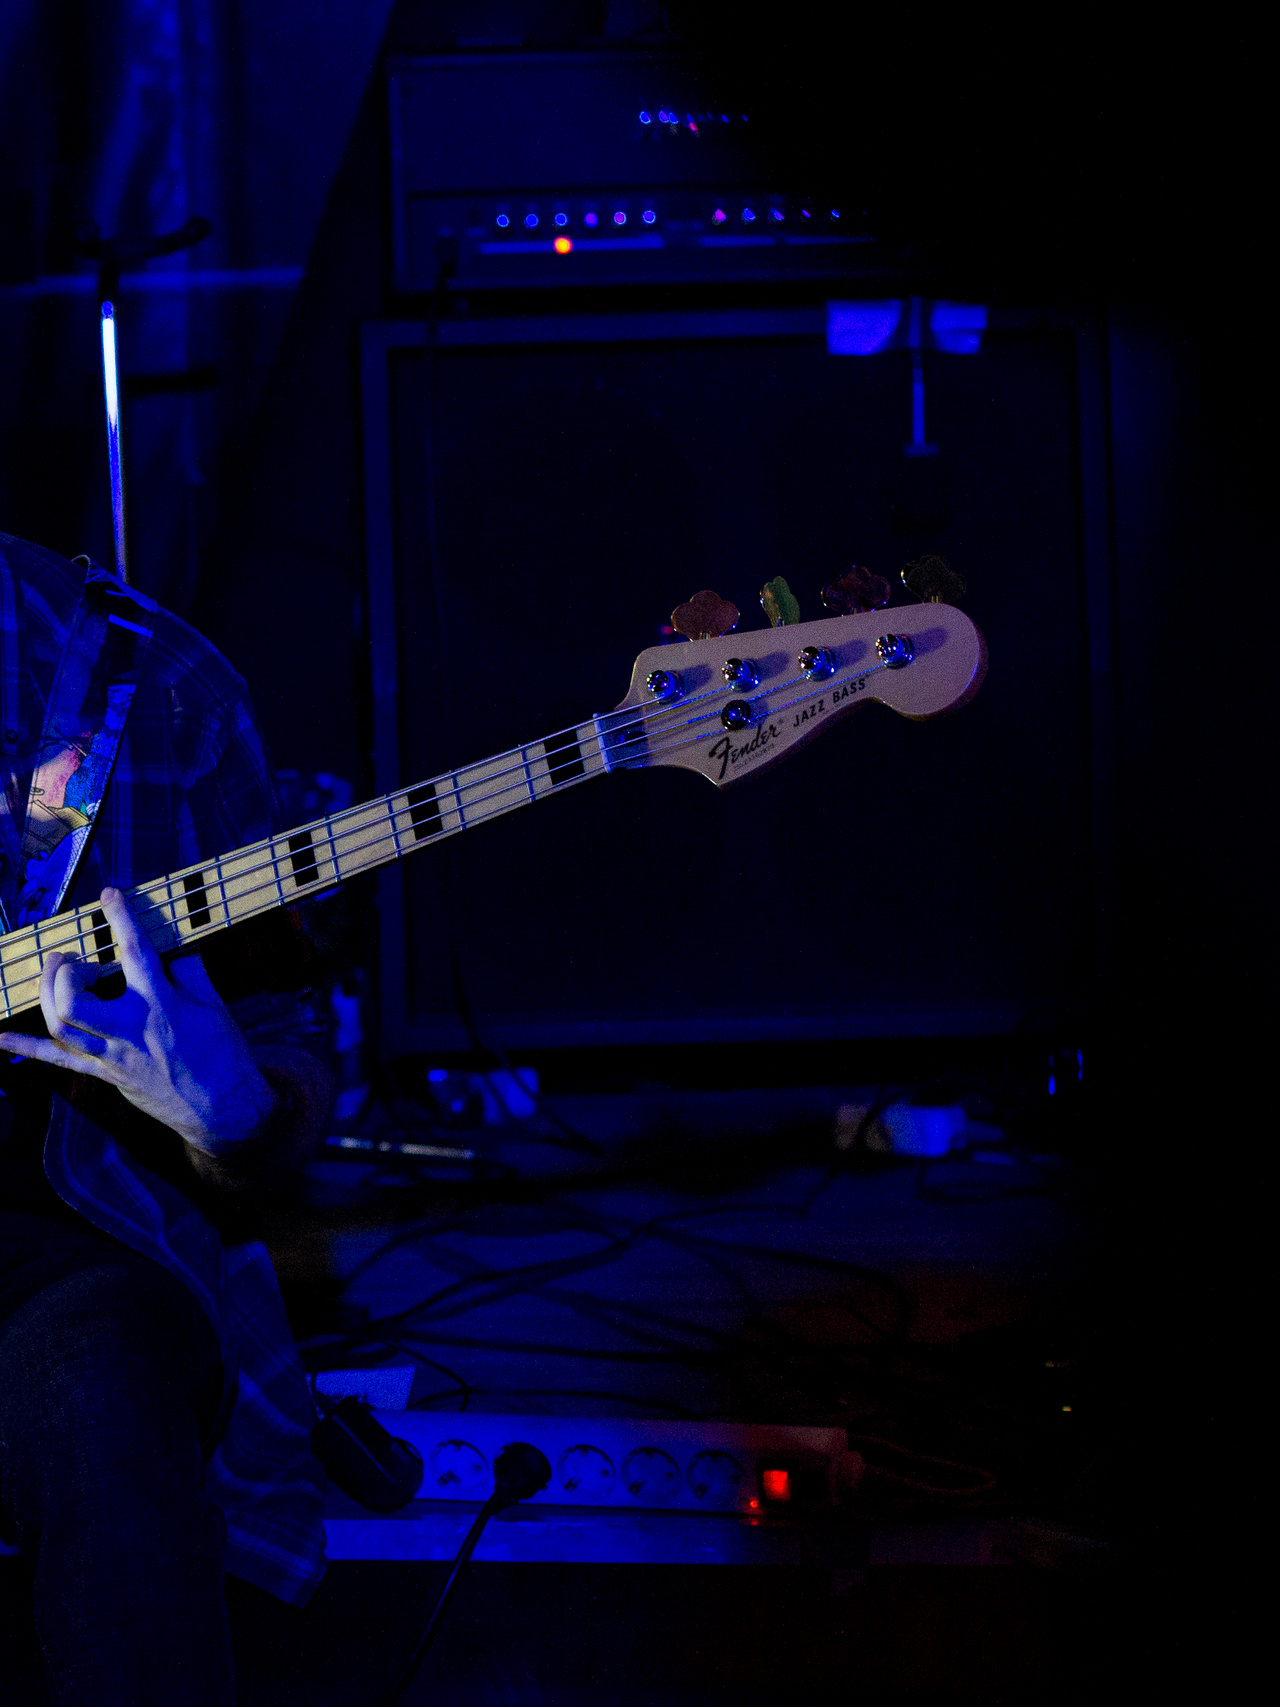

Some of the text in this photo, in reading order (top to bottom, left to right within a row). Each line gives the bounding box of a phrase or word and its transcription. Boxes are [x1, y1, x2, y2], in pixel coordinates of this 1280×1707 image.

[793, 678, 866, 728] JAZZ BASS
[709, 724, 781, 780] Fender
